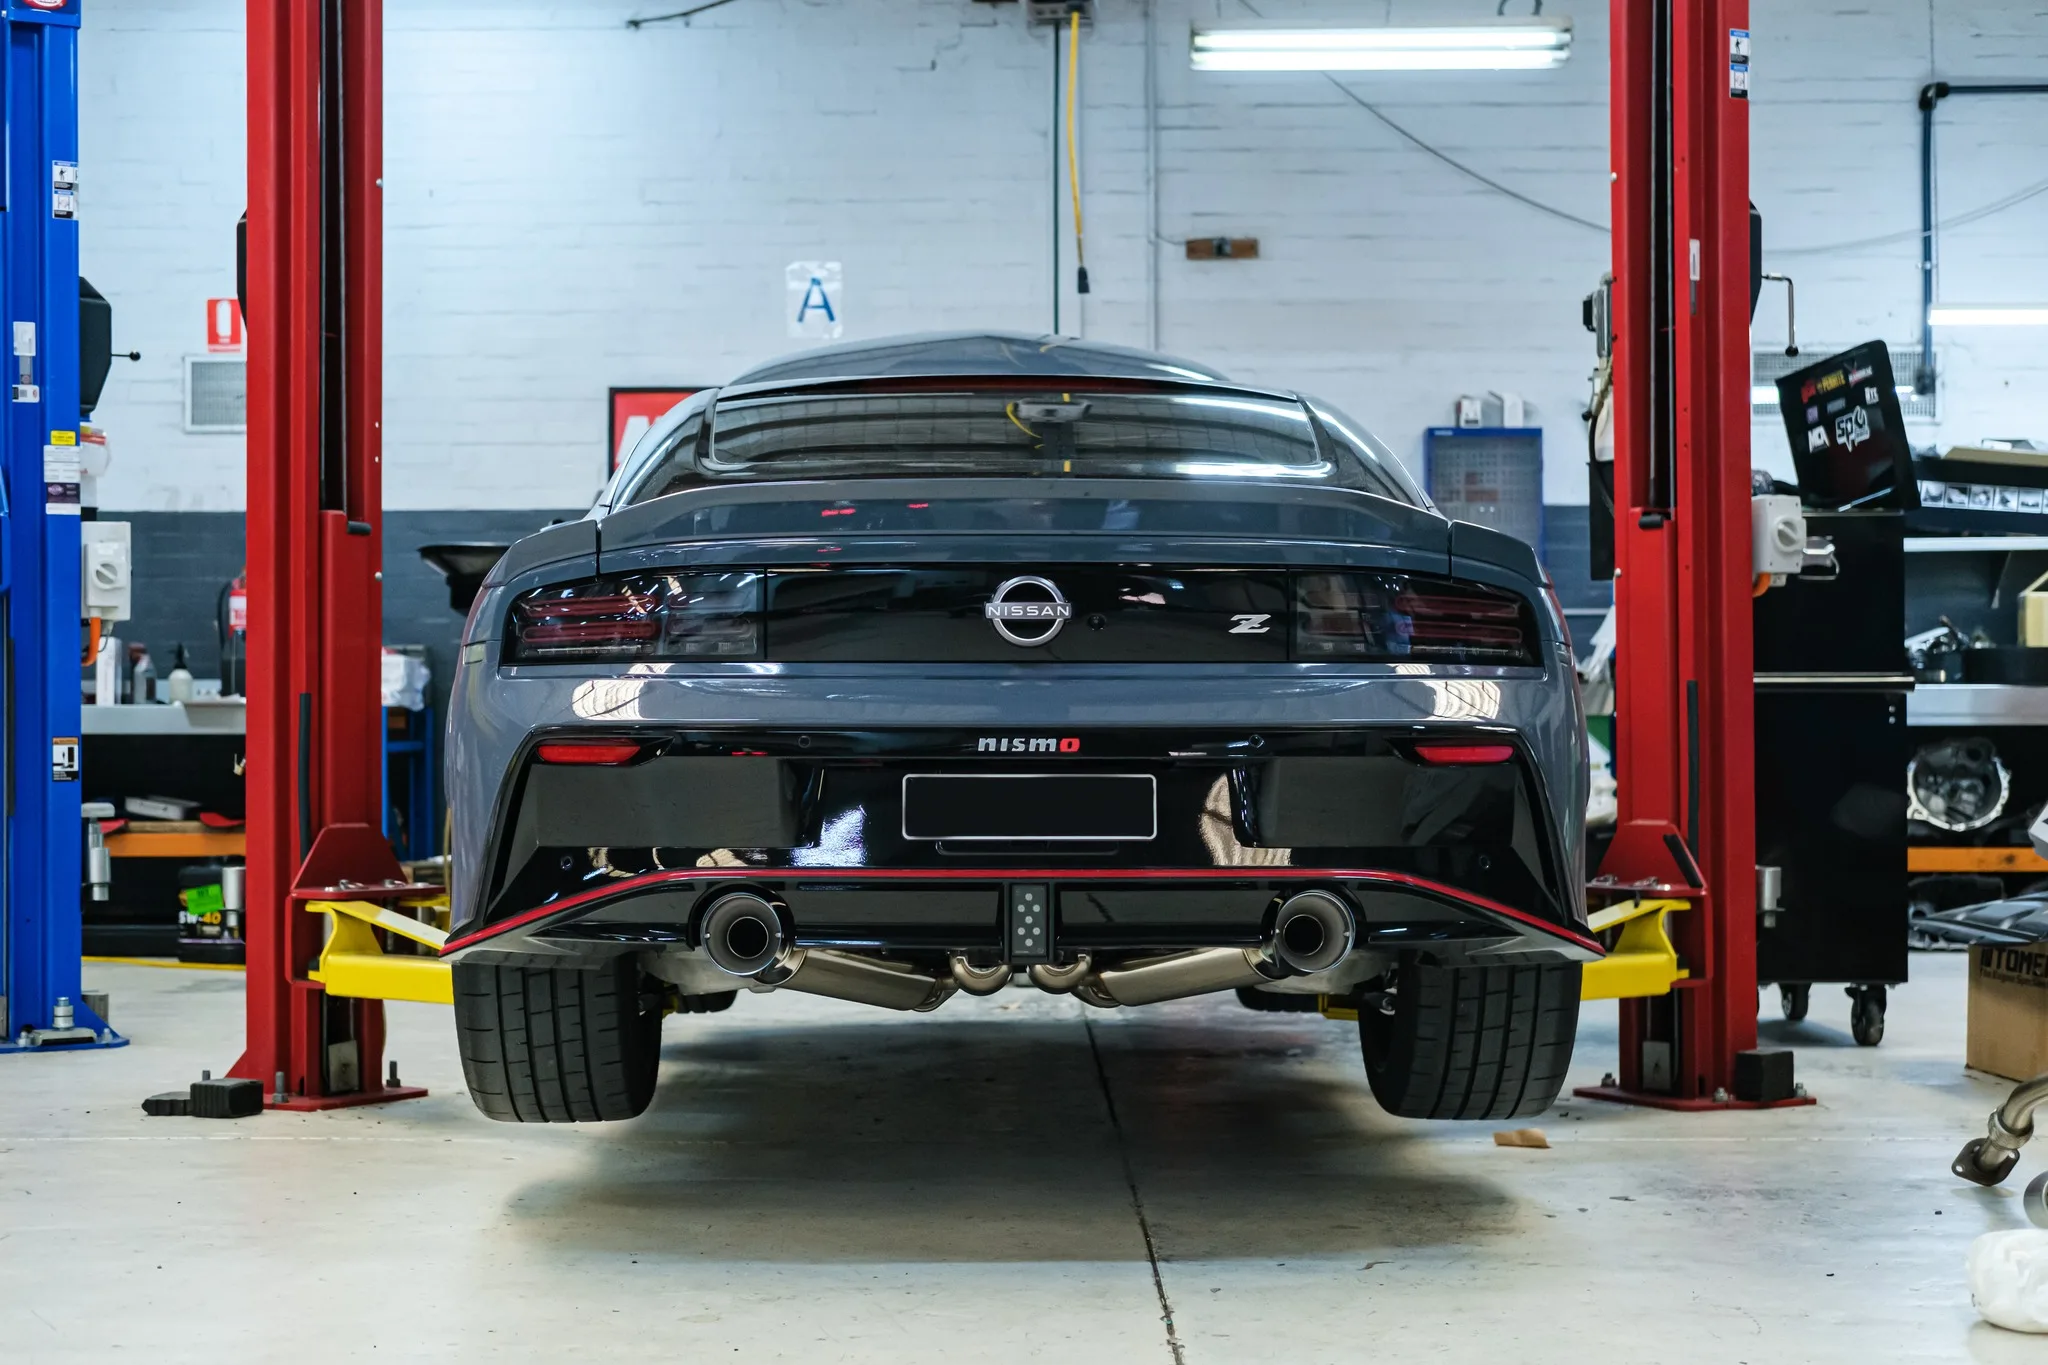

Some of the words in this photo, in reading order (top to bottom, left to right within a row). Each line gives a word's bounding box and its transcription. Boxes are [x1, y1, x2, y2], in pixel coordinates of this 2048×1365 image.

[797, 277, 835, 323] A
[988, 605, 1070, 617] NISSAN
[1228, 613, 1271, 634] Z
